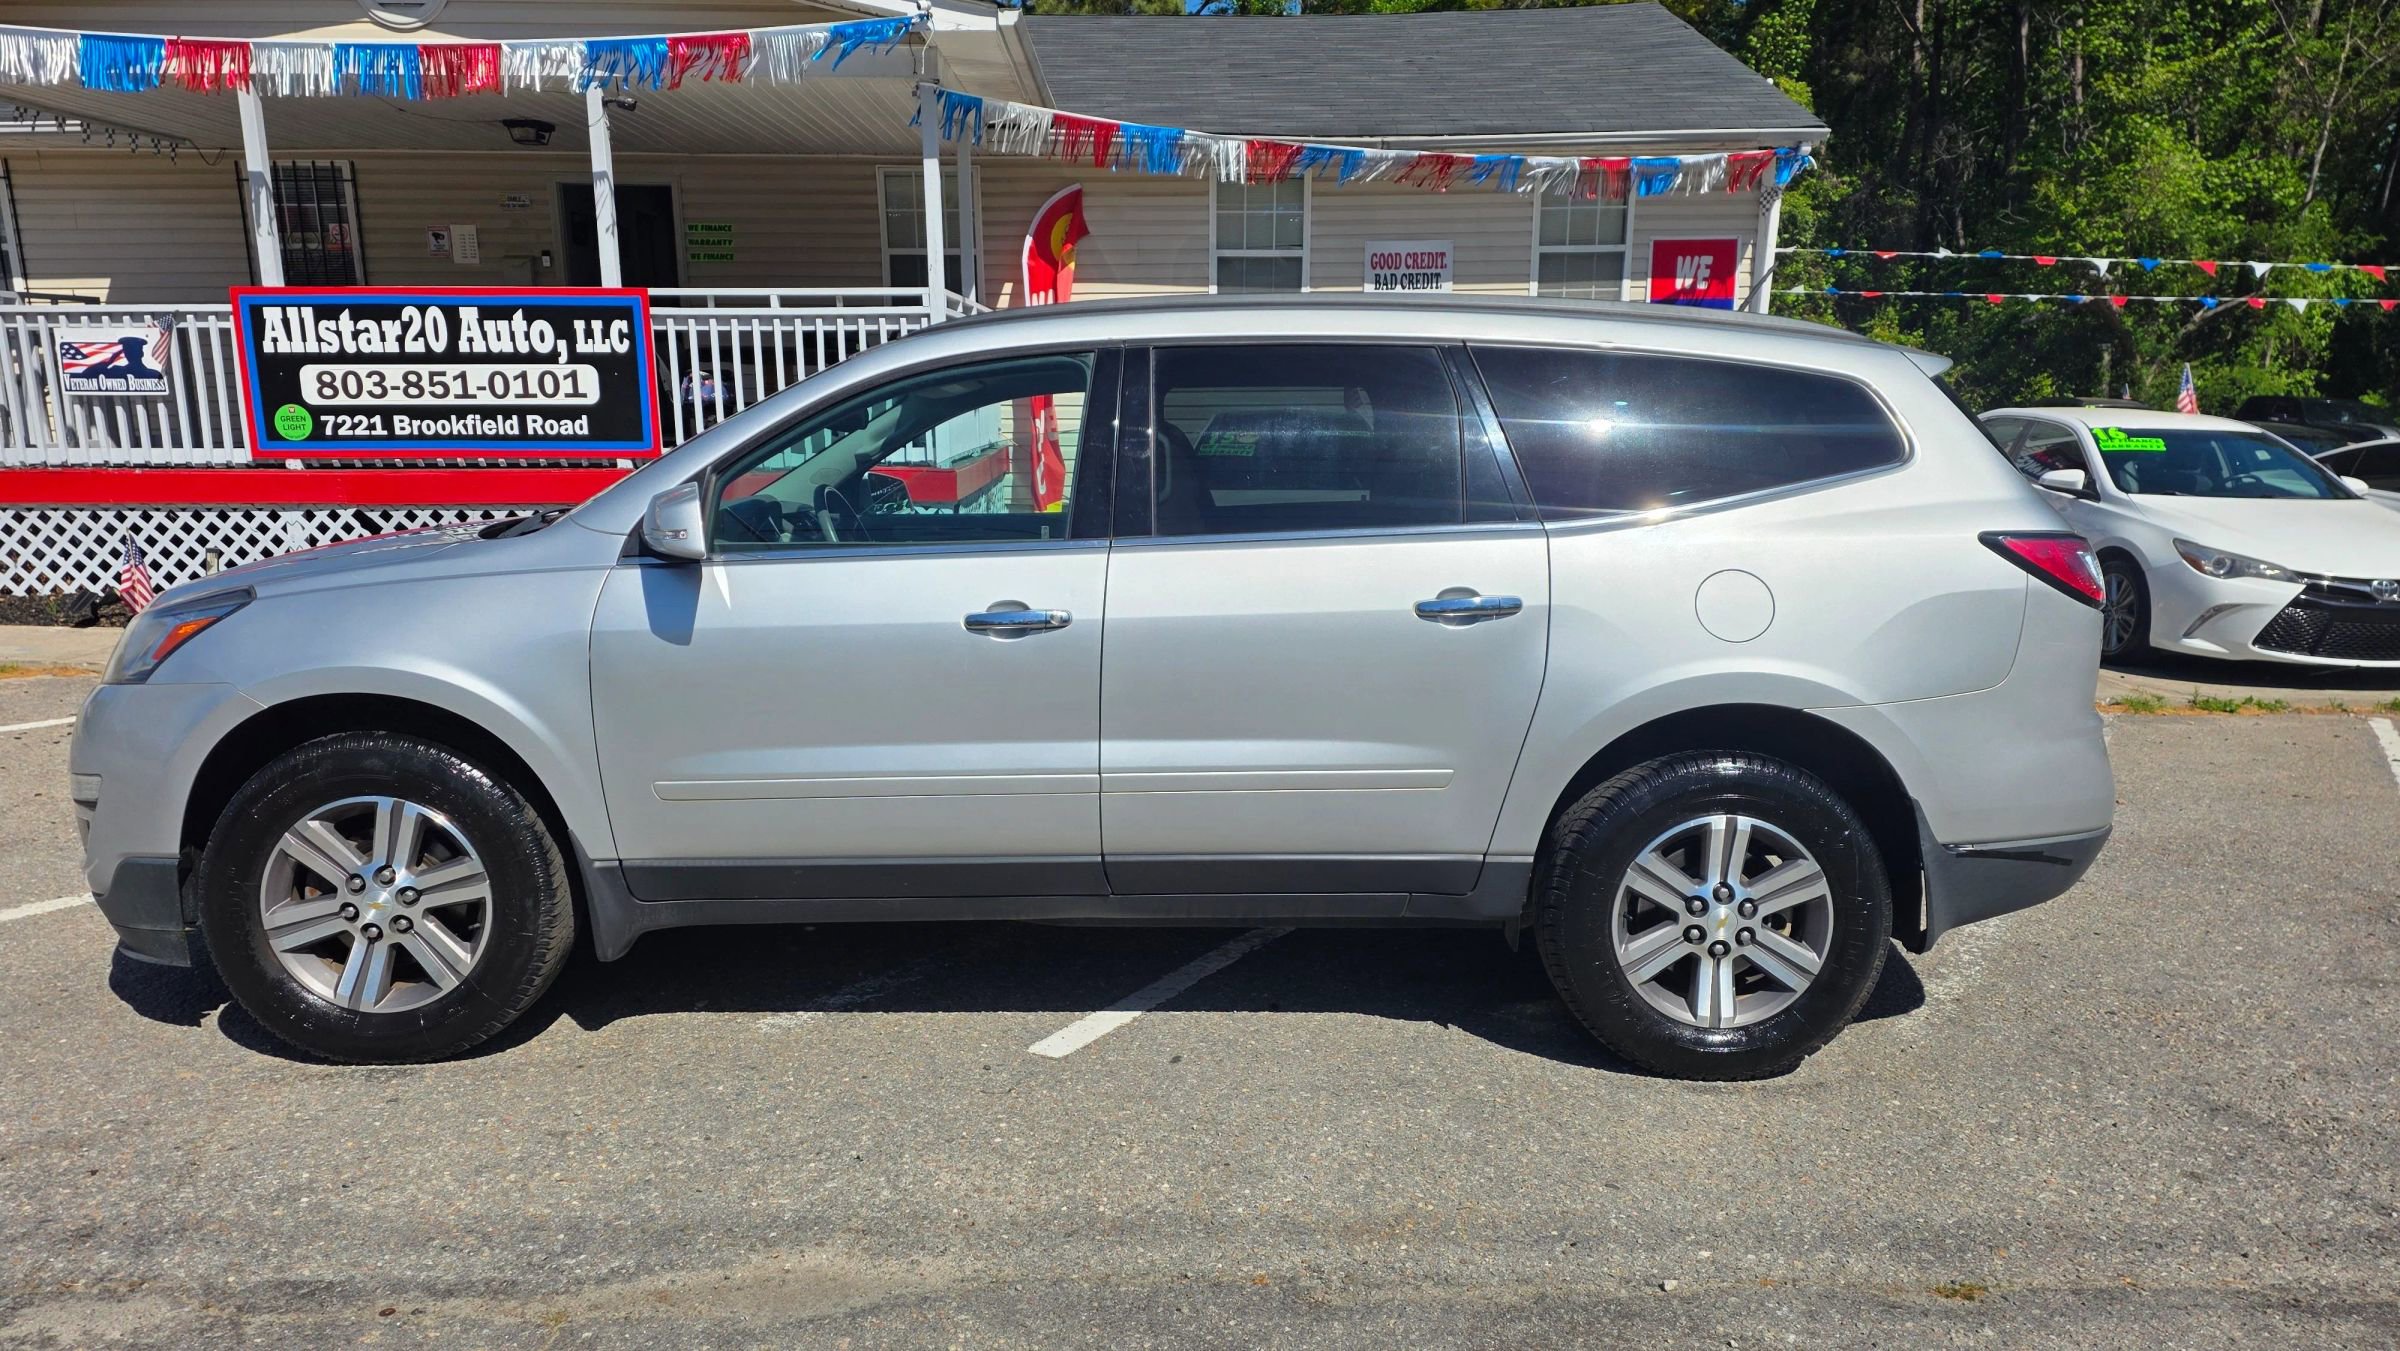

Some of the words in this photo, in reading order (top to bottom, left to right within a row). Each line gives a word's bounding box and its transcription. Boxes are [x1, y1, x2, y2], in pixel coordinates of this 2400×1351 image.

[700, 224, 732, 232] FINANCE
[687, 238, 733, 246] WARRANTY
[1370, 252, 1402, 270] GOOD
[1404, 251, 1447, 270] CREDIT.
[1374, 273, 1398, 291] BAD
[1400, 272, 1442, 290] CREDIT.
[1675, 255, 1714, 290] WE
[262, 306, 448, 354] Allstar20
[458, 306, 568, 364] Auto,
[573, 319, 631, 354] LLC
[315, 369, 588, 400] 803-851-0101
[280, 415, 307, 423] GREEN
[282, 423, 306, 431] LIGHT
[320, 414, 388, 436] 7221
[393, 414, 520, 436] Brookfield
[526, 414, 589, 436] Road
[2091, 427, 2128, 440] 16
